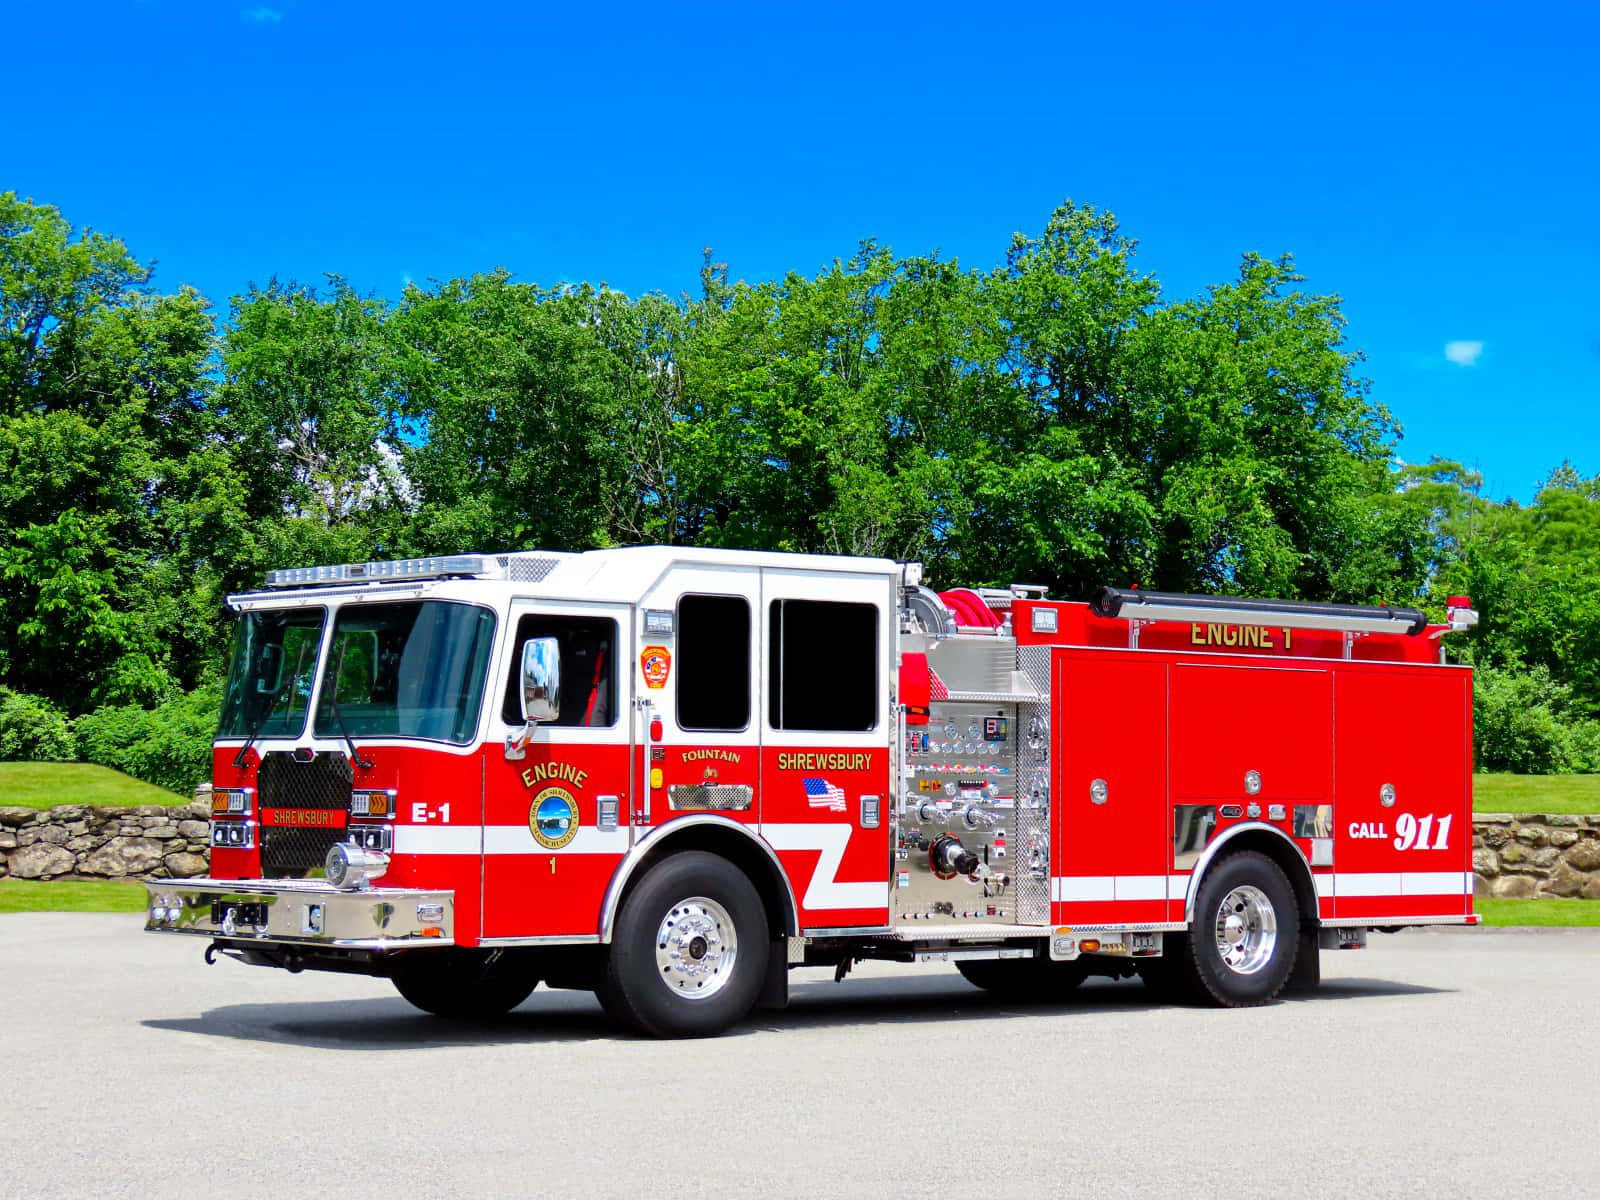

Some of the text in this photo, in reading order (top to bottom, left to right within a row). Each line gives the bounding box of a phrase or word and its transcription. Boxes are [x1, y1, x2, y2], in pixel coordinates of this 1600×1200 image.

[1191, 622, 1291, 649] ENGINE 1
[682, 749, 741, 763] FOUNTAIN
[778, 753, 872, 770] SHREWSBURY
[521, 761, 588, 789] ENGINE
[273, 810, 334, 825] SHREWSBURY
[411, 802, 450, 823] E-1
[1348, 812, 1453, 851] CALL 911
[549, 856, 556, 875] 1
